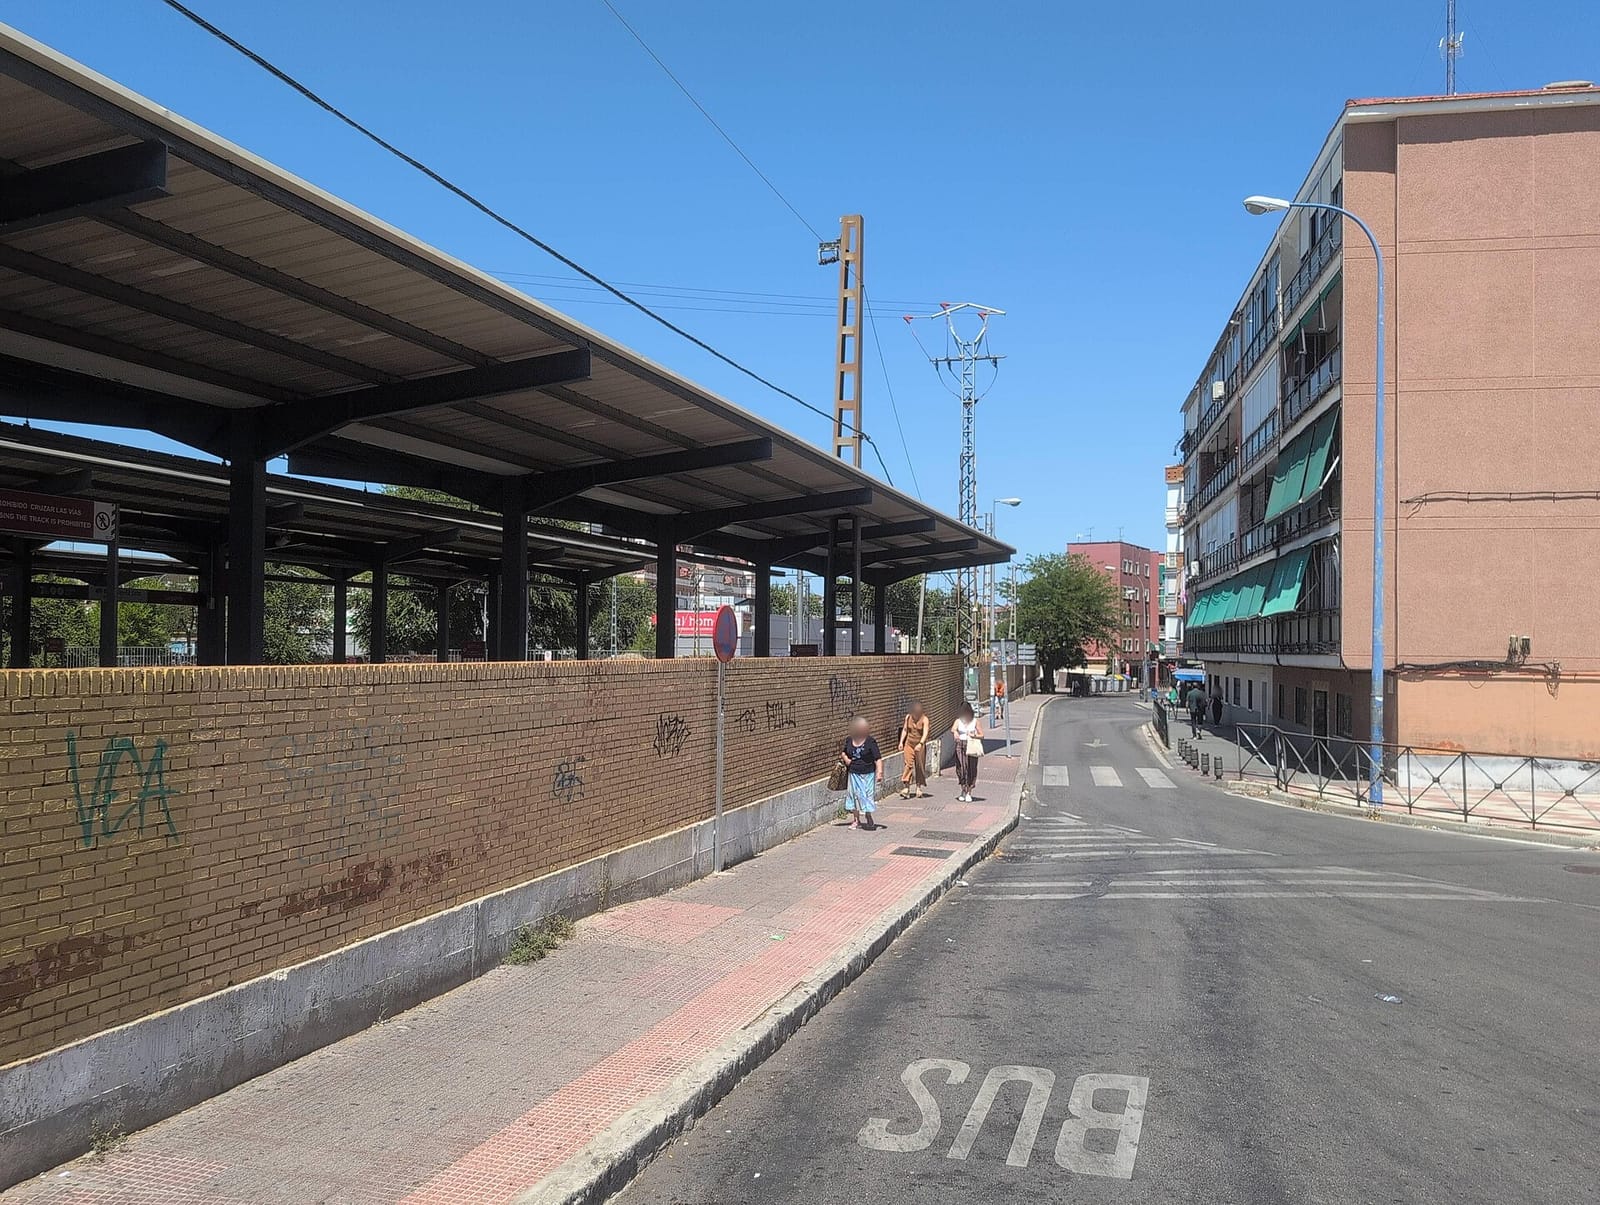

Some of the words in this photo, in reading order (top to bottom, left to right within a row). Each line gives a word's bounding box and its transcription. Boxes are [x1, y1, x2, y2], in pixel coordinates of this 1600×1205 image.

[0, 500, 28, 510] OHIBIDO
[30, 503, 55, 513] CRUZAR
[56, 506, 67, 514] LAS
[15, 513, 28, 522] THE
[29, 515, 49, 525] TRACK
[57, 518, 92, 529] PROHIBITED
[689, 616, 713, 627] hom
[857, 1058, 1150, 1179] BUS
